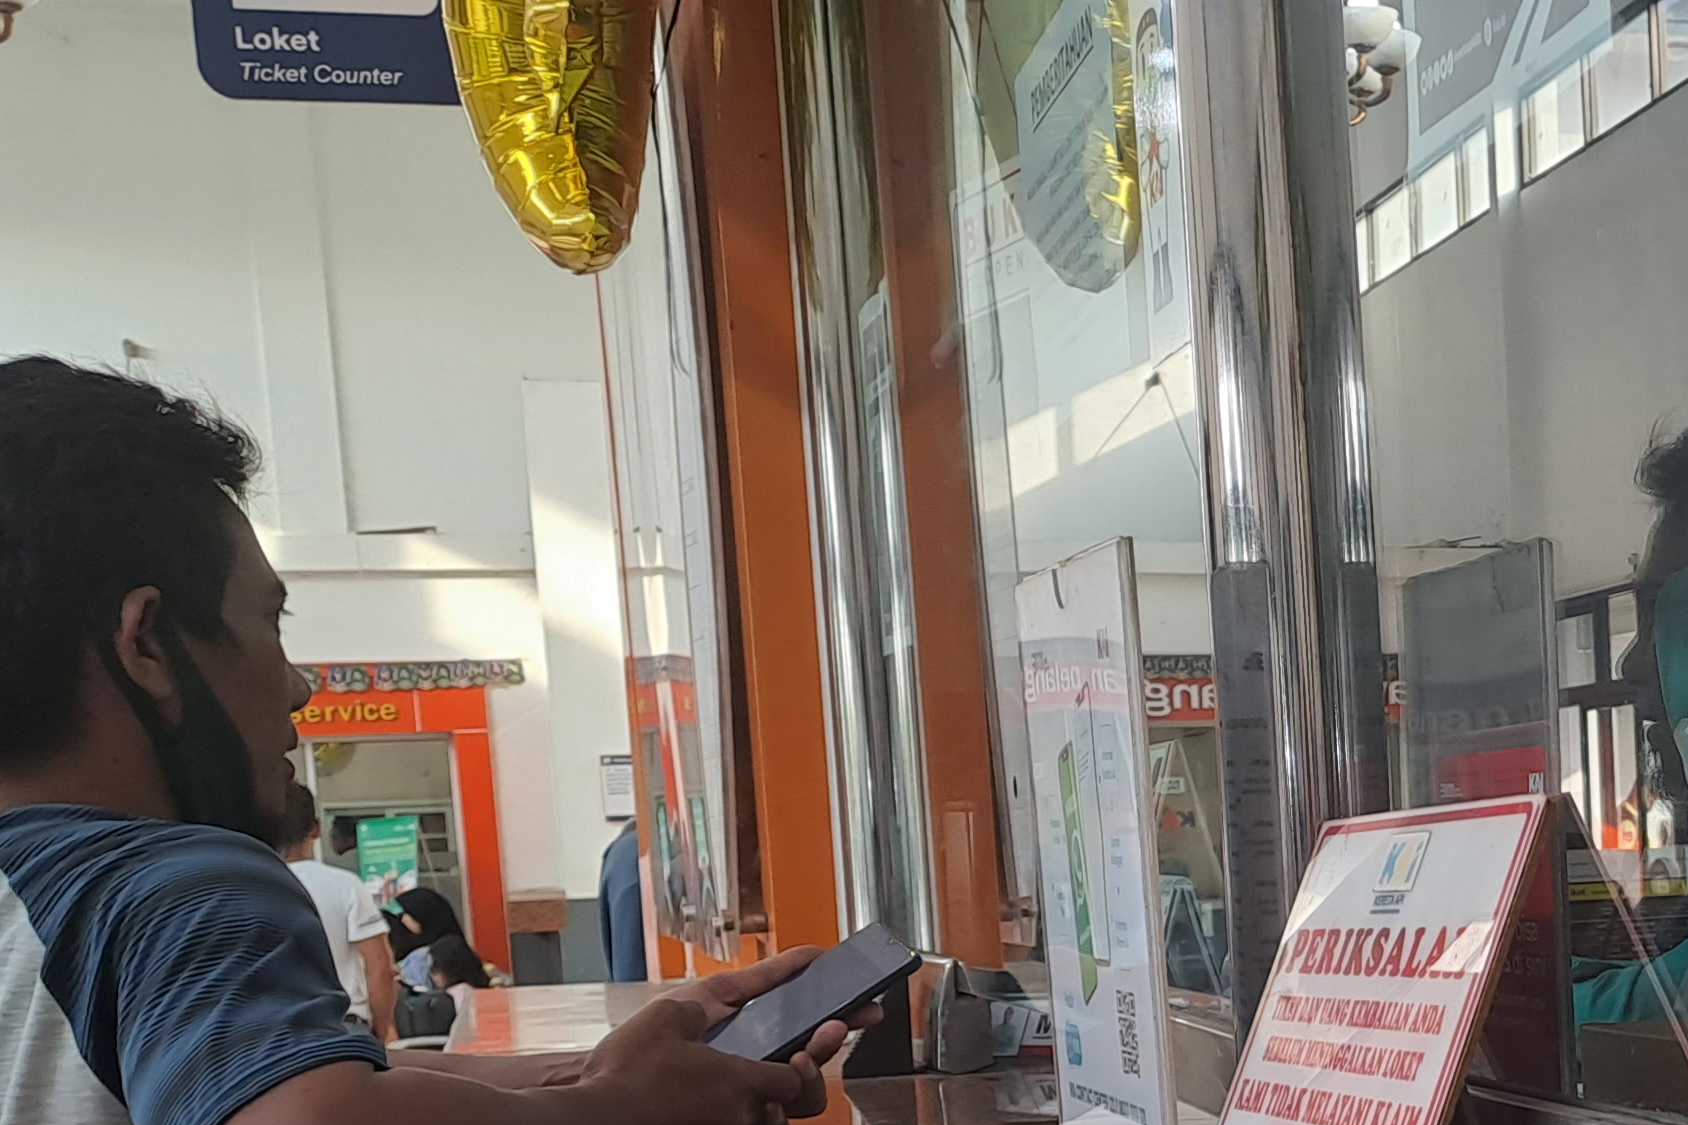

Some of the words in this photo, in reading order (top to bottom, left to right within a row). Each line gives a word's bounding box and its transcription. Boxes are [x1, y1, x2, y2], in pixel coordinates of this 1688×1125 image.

[234, 25, 321, 52] Loket
[239, 62, 307, 83] Ticket
[313, 64, 404, 85] Counter
[1409, 1003, 1446, 1036] ANDA
[1382, 1049, 1426, 1082] LOKET
[1234, 1078, 1271, 1114] KAMI
[1265, 1083, 1308, 1122] TIDAK
